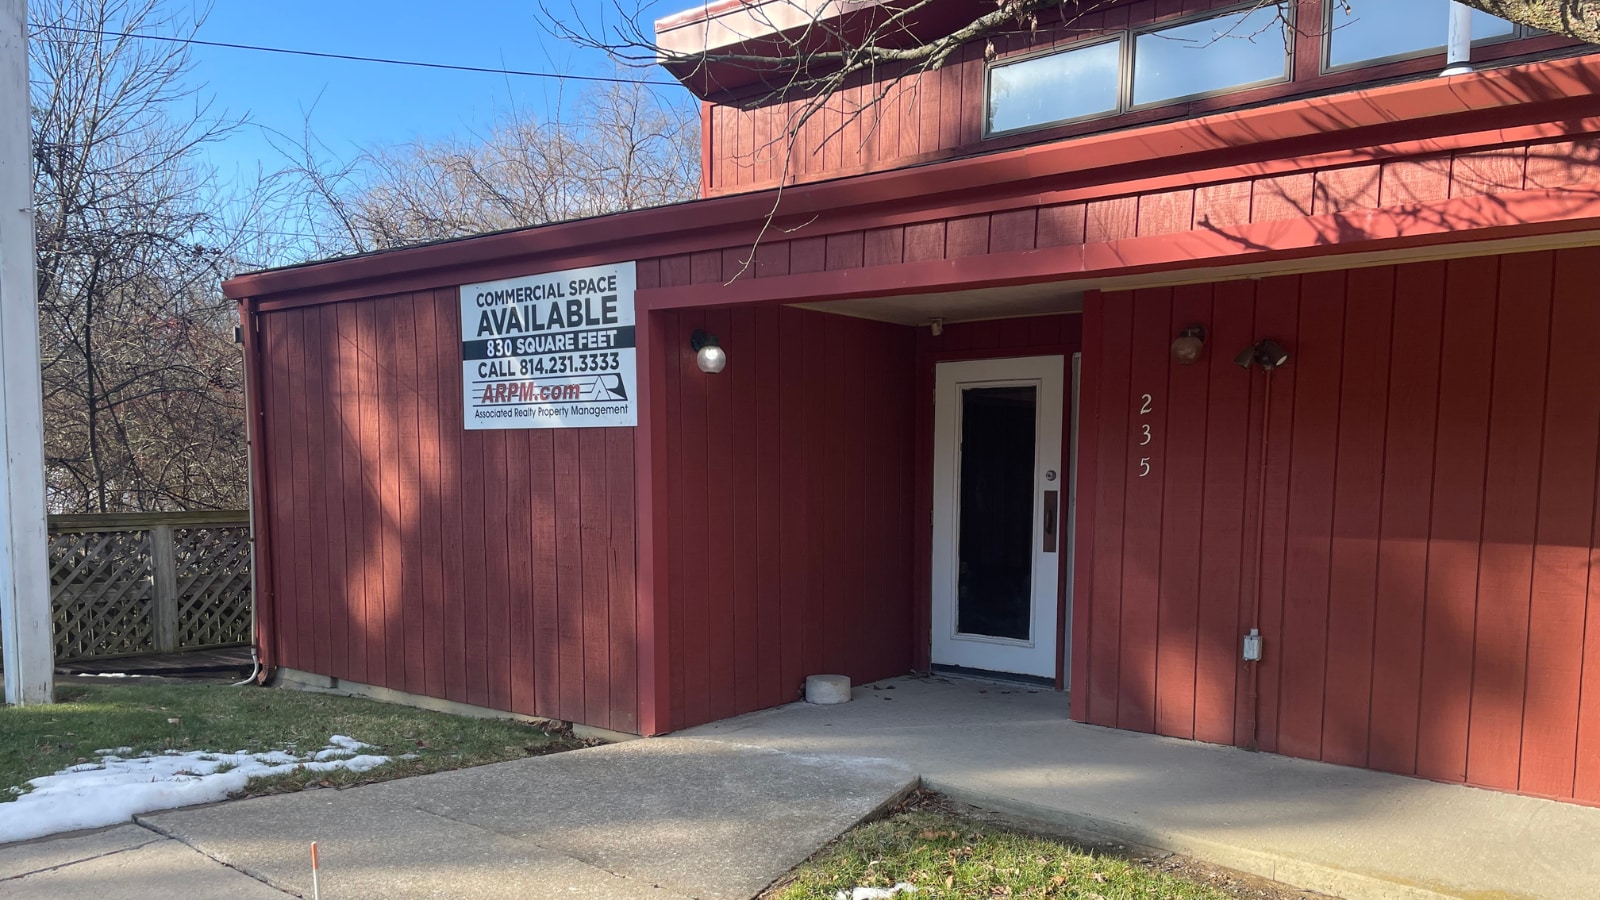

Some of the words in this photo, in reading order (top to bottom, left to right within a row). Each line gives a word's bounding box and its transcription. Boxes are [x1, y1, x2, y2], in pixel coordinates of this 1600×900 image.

[476, 282, 565, 308] COMMERCIAL
[569, 275, 617, 297] SPACE
[477, 294, 618, 337] AVAILABLE
[486, 338, 513, 357] 830
[516, 332, 575, 354] SQUARE
[578, 329, 617, 349] FEET
[478, 359, 516, 379] CALL
[519, 351, 620, 376] 814.231.3333
[481, 382, 581, 404] ARPM.com
[475, 407, 513, 419] Associated
[514, 406, 537, 419] Realty
[538, 405, 569, 419] Property
[571, 403, 629, 417] Management
